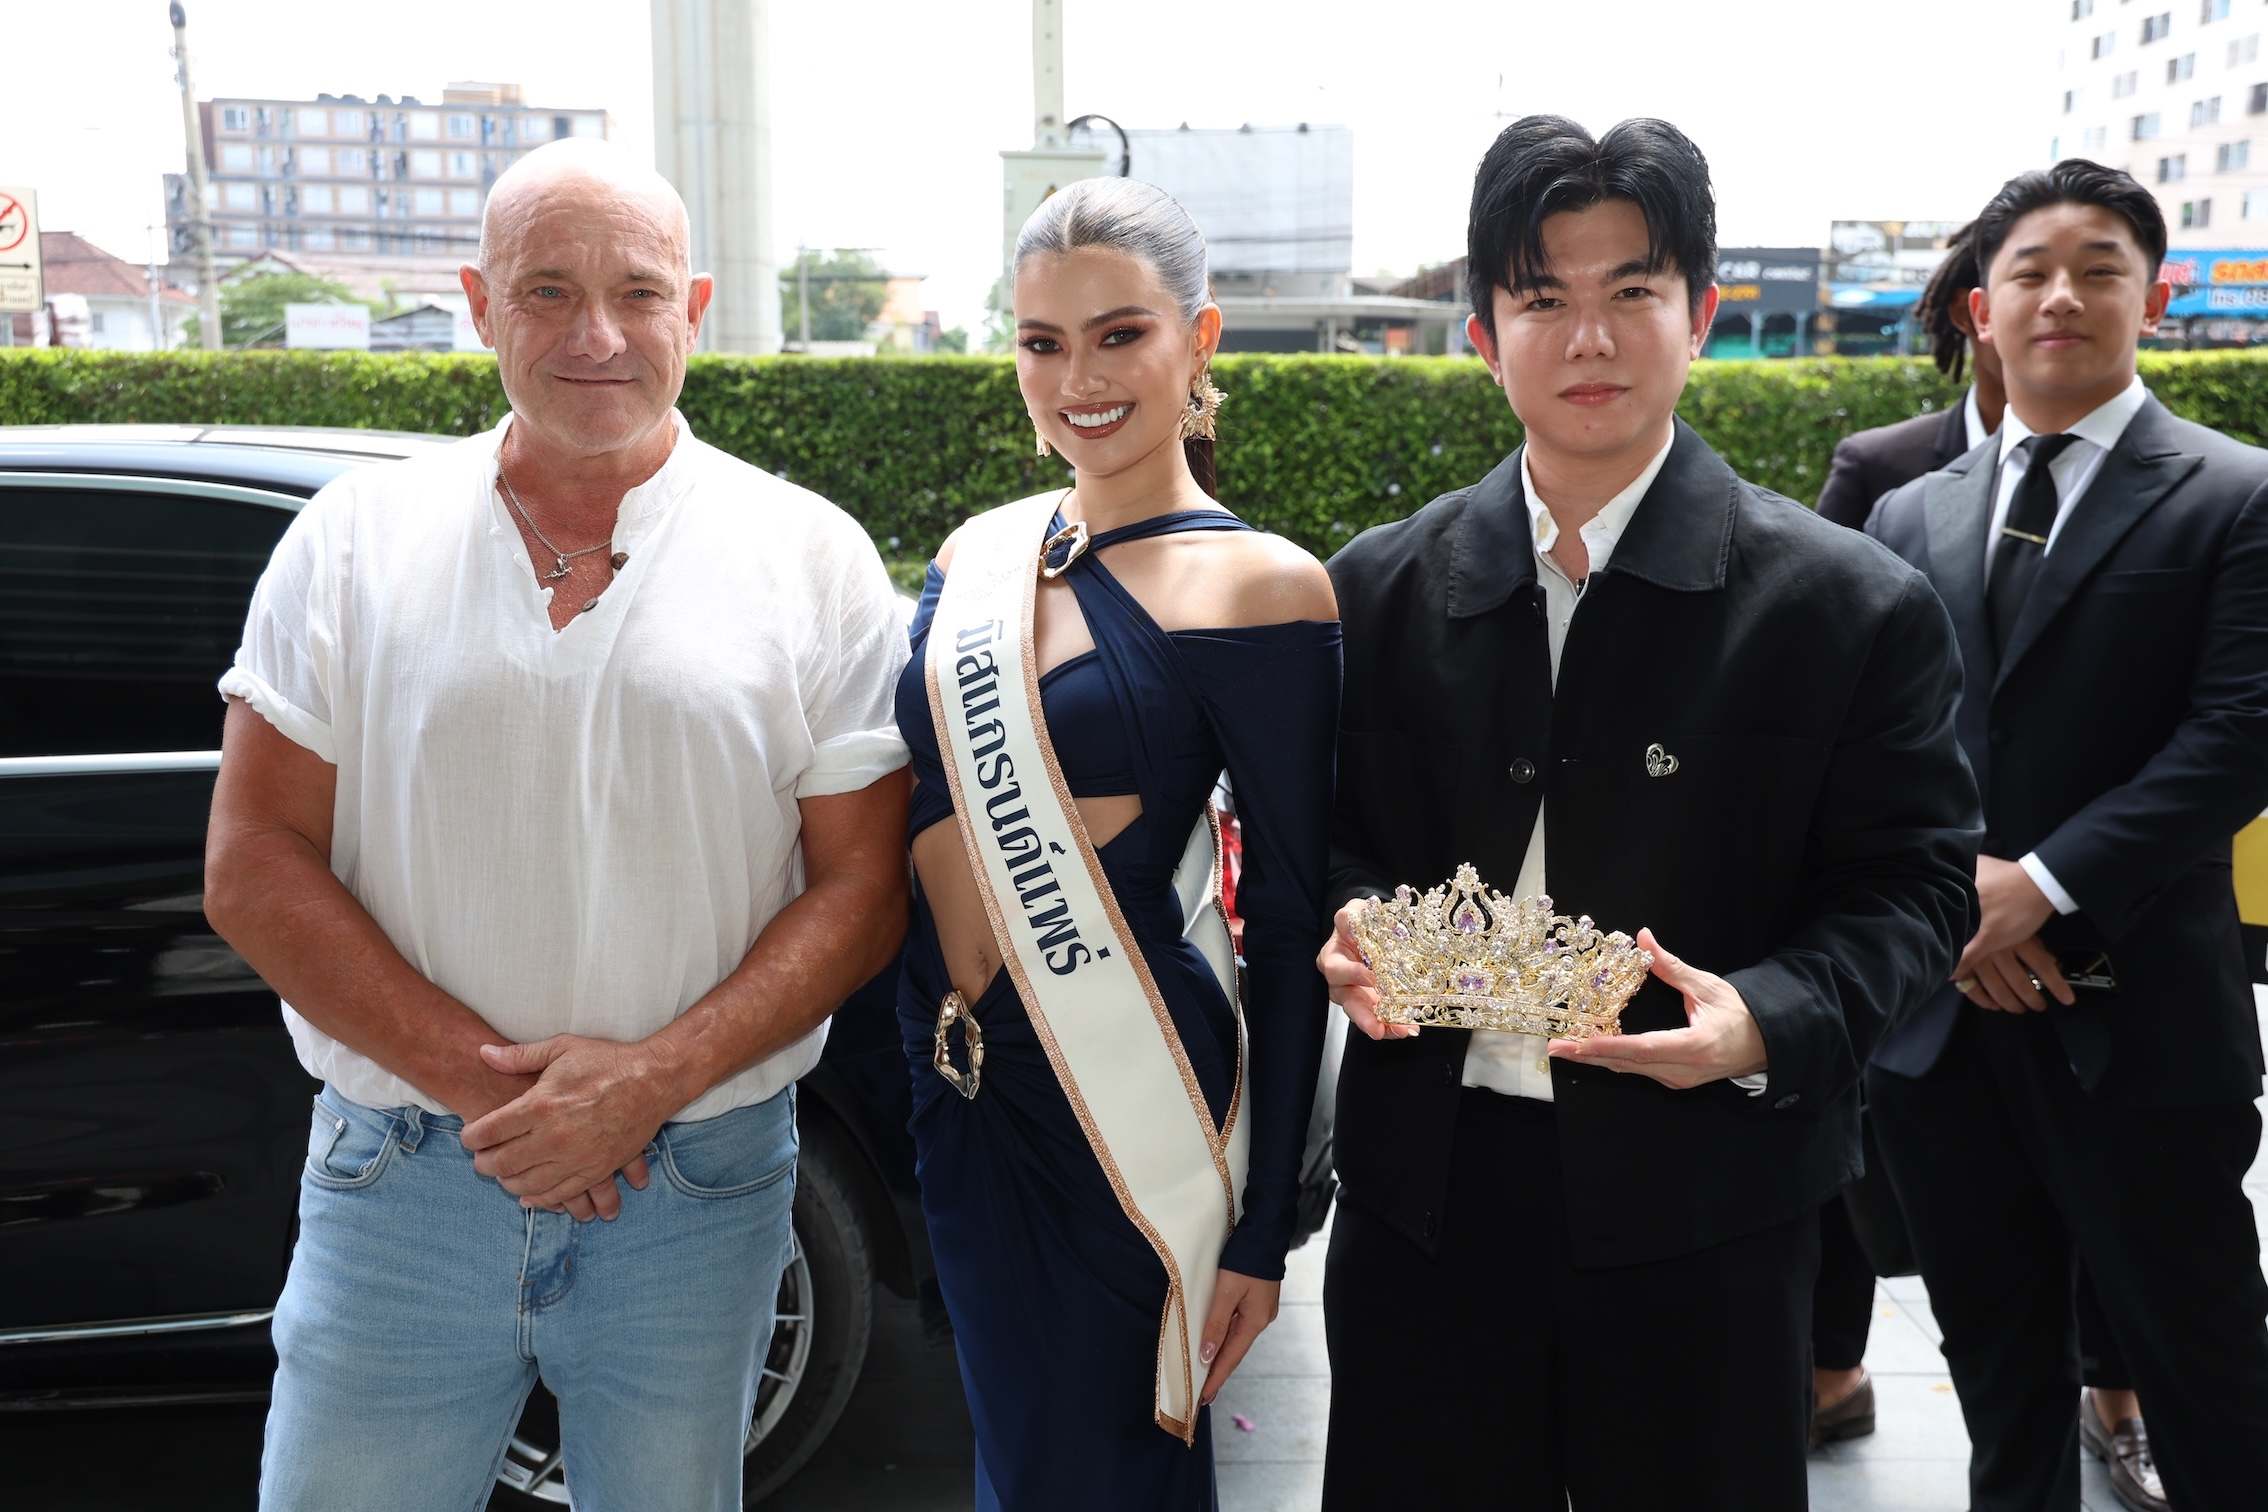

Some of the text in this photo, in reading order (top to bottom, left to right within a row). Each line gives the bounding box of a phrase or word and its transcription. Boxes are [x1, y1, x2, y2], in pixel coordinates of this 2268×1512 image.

[956, 618, 1111, 976] มิสแกรนด์แพร่
